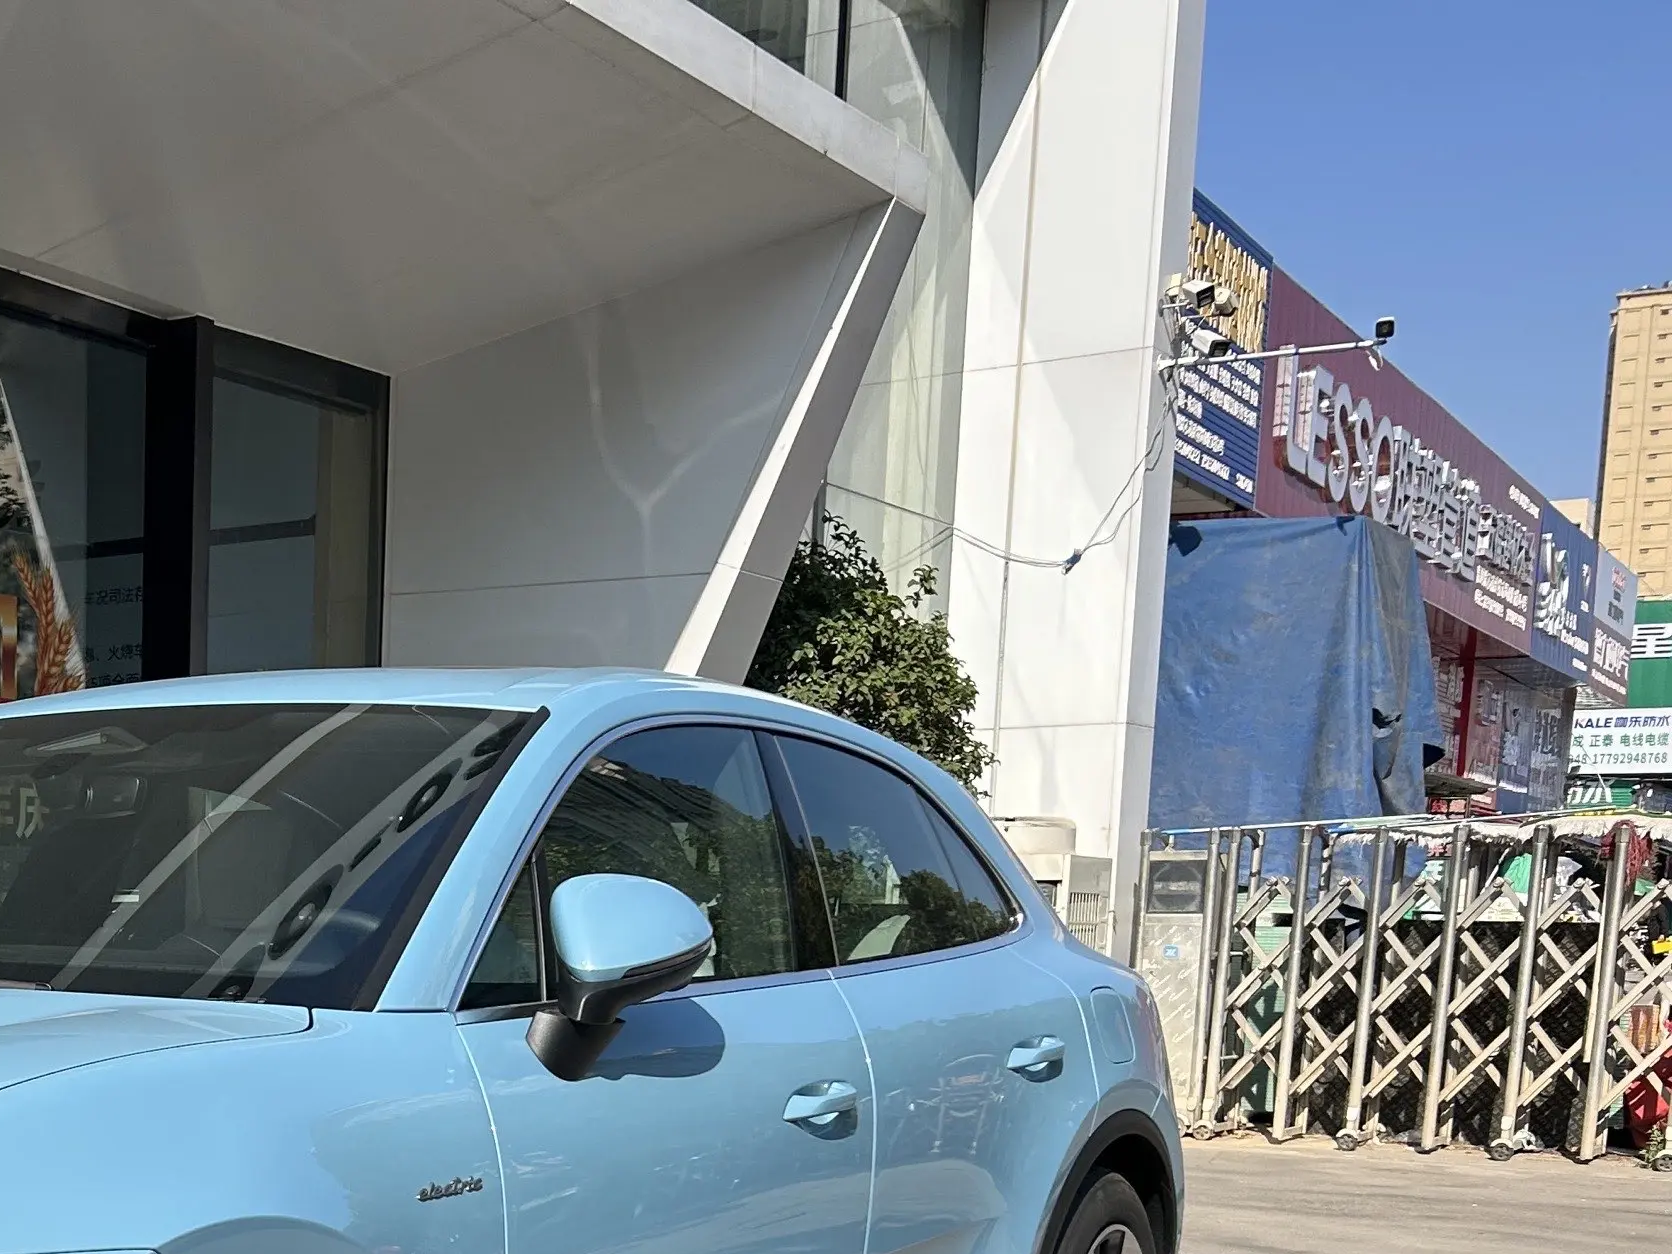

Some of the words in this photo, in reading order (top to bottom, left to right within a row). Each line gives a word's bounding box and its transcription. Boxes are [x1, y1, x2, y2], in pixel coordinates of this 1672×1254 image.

[1272, 344, 1394, 525] LESSO
[1574, 717, 1613, 729] KALE
[1614, 715, 1671, 728] 咖乐防水
[1589, 734, 1614, 747] 正泰
[1620, 733, 1670, 747] 电线电缆
[1592, 752, 1668, 764] 17792948768
[417, 1175, 484, 1202] electric
